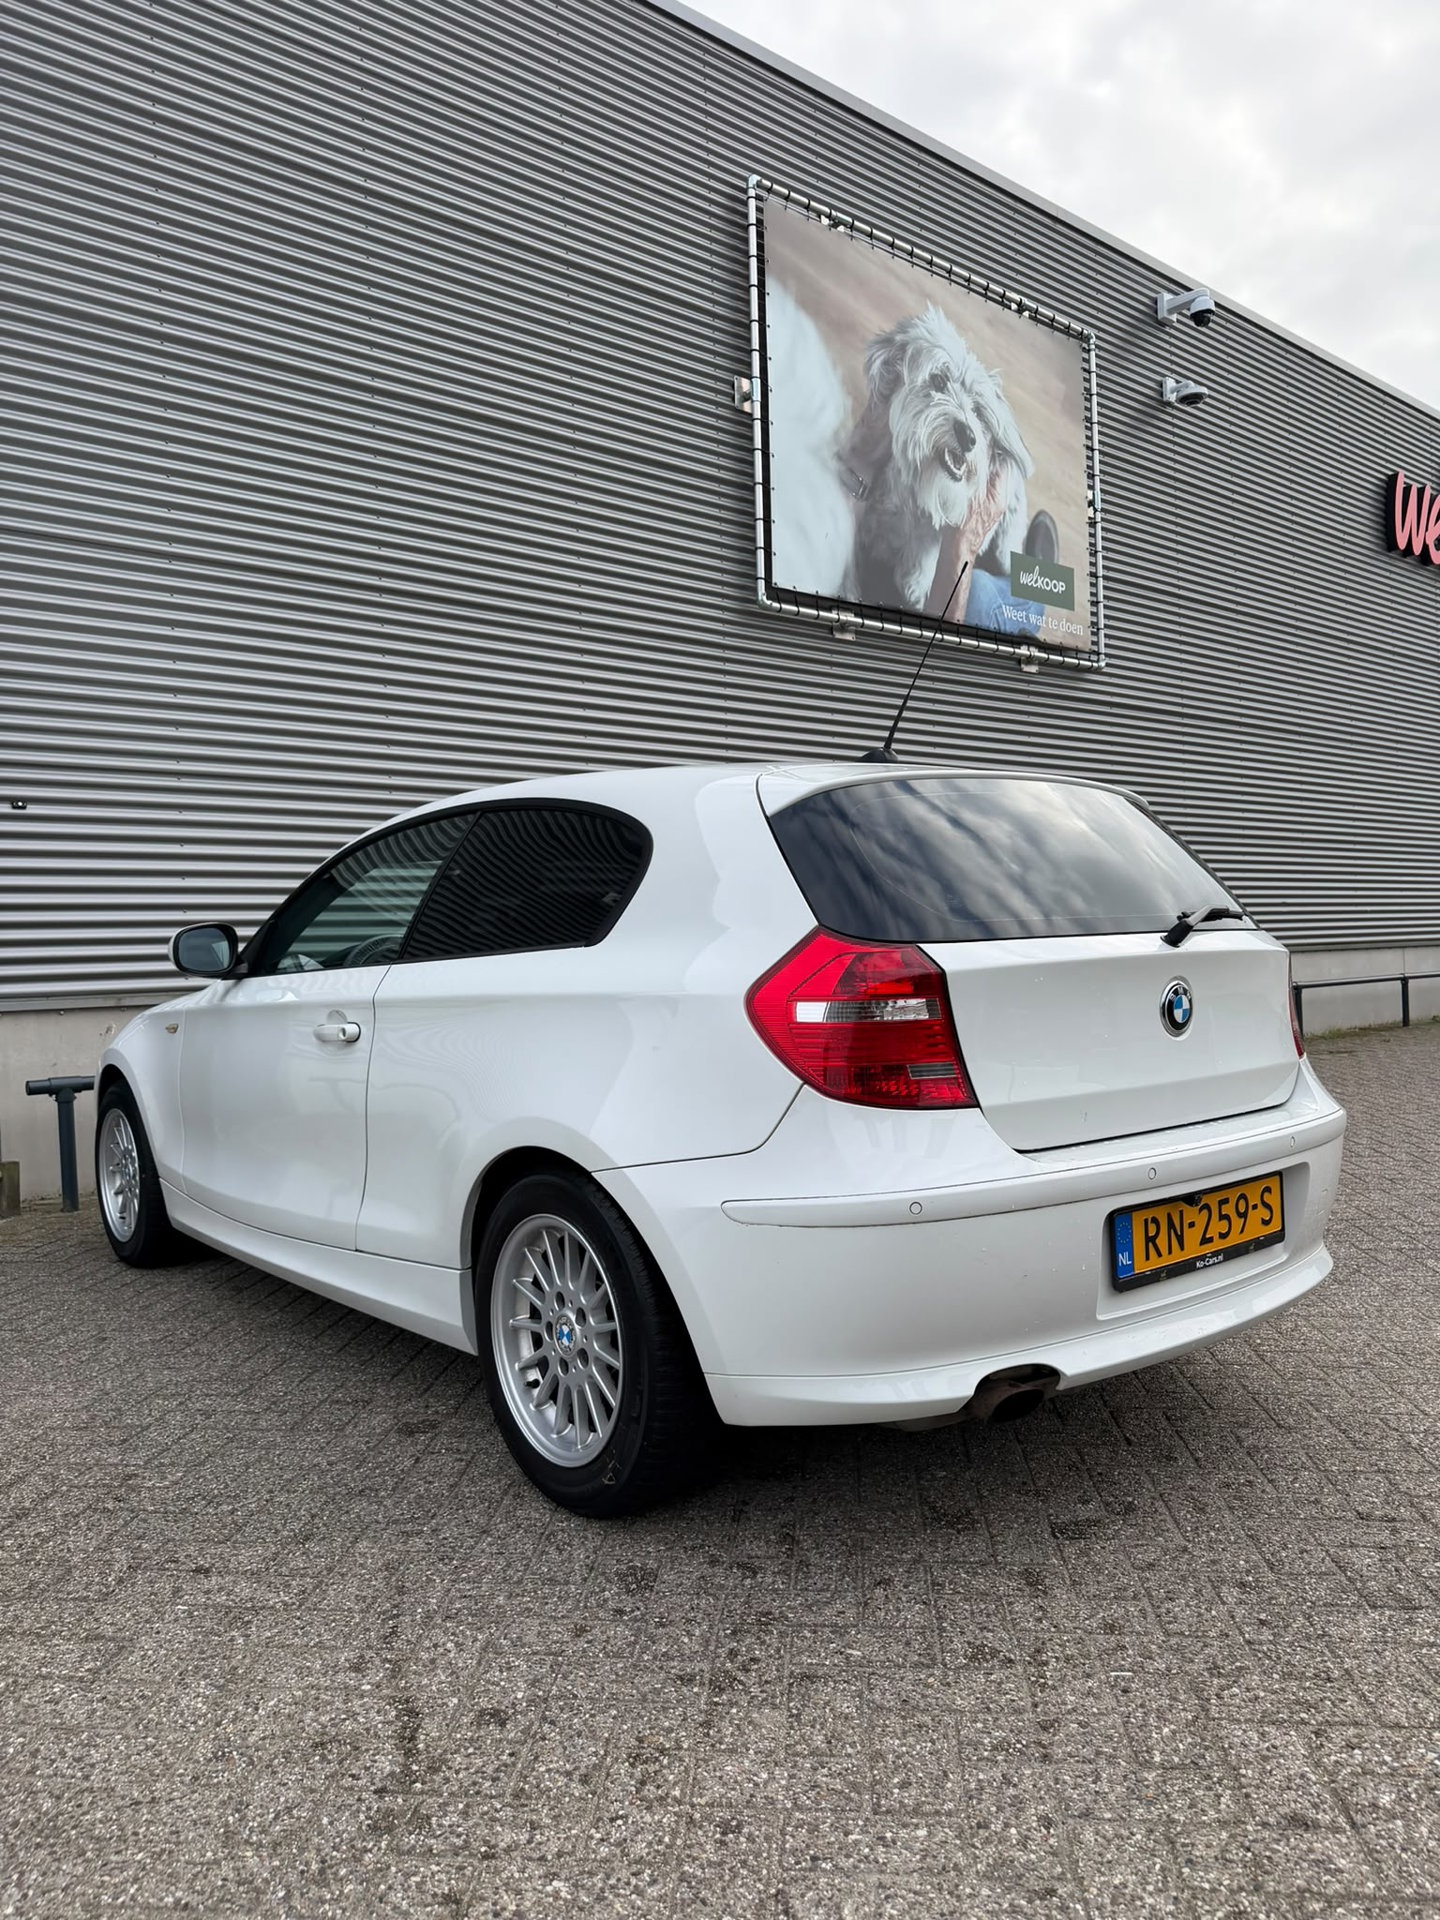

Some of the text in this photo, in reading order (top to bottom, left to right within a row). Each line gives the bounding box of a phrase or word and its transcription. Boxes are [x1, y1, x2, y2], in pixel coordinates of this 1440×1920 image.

[1002, 604, 1083, 636] Weet wat te doen
[1143, 1185, 1274, 1262] RN-259-S
[1118, 1252, 1132, 1266] NL
